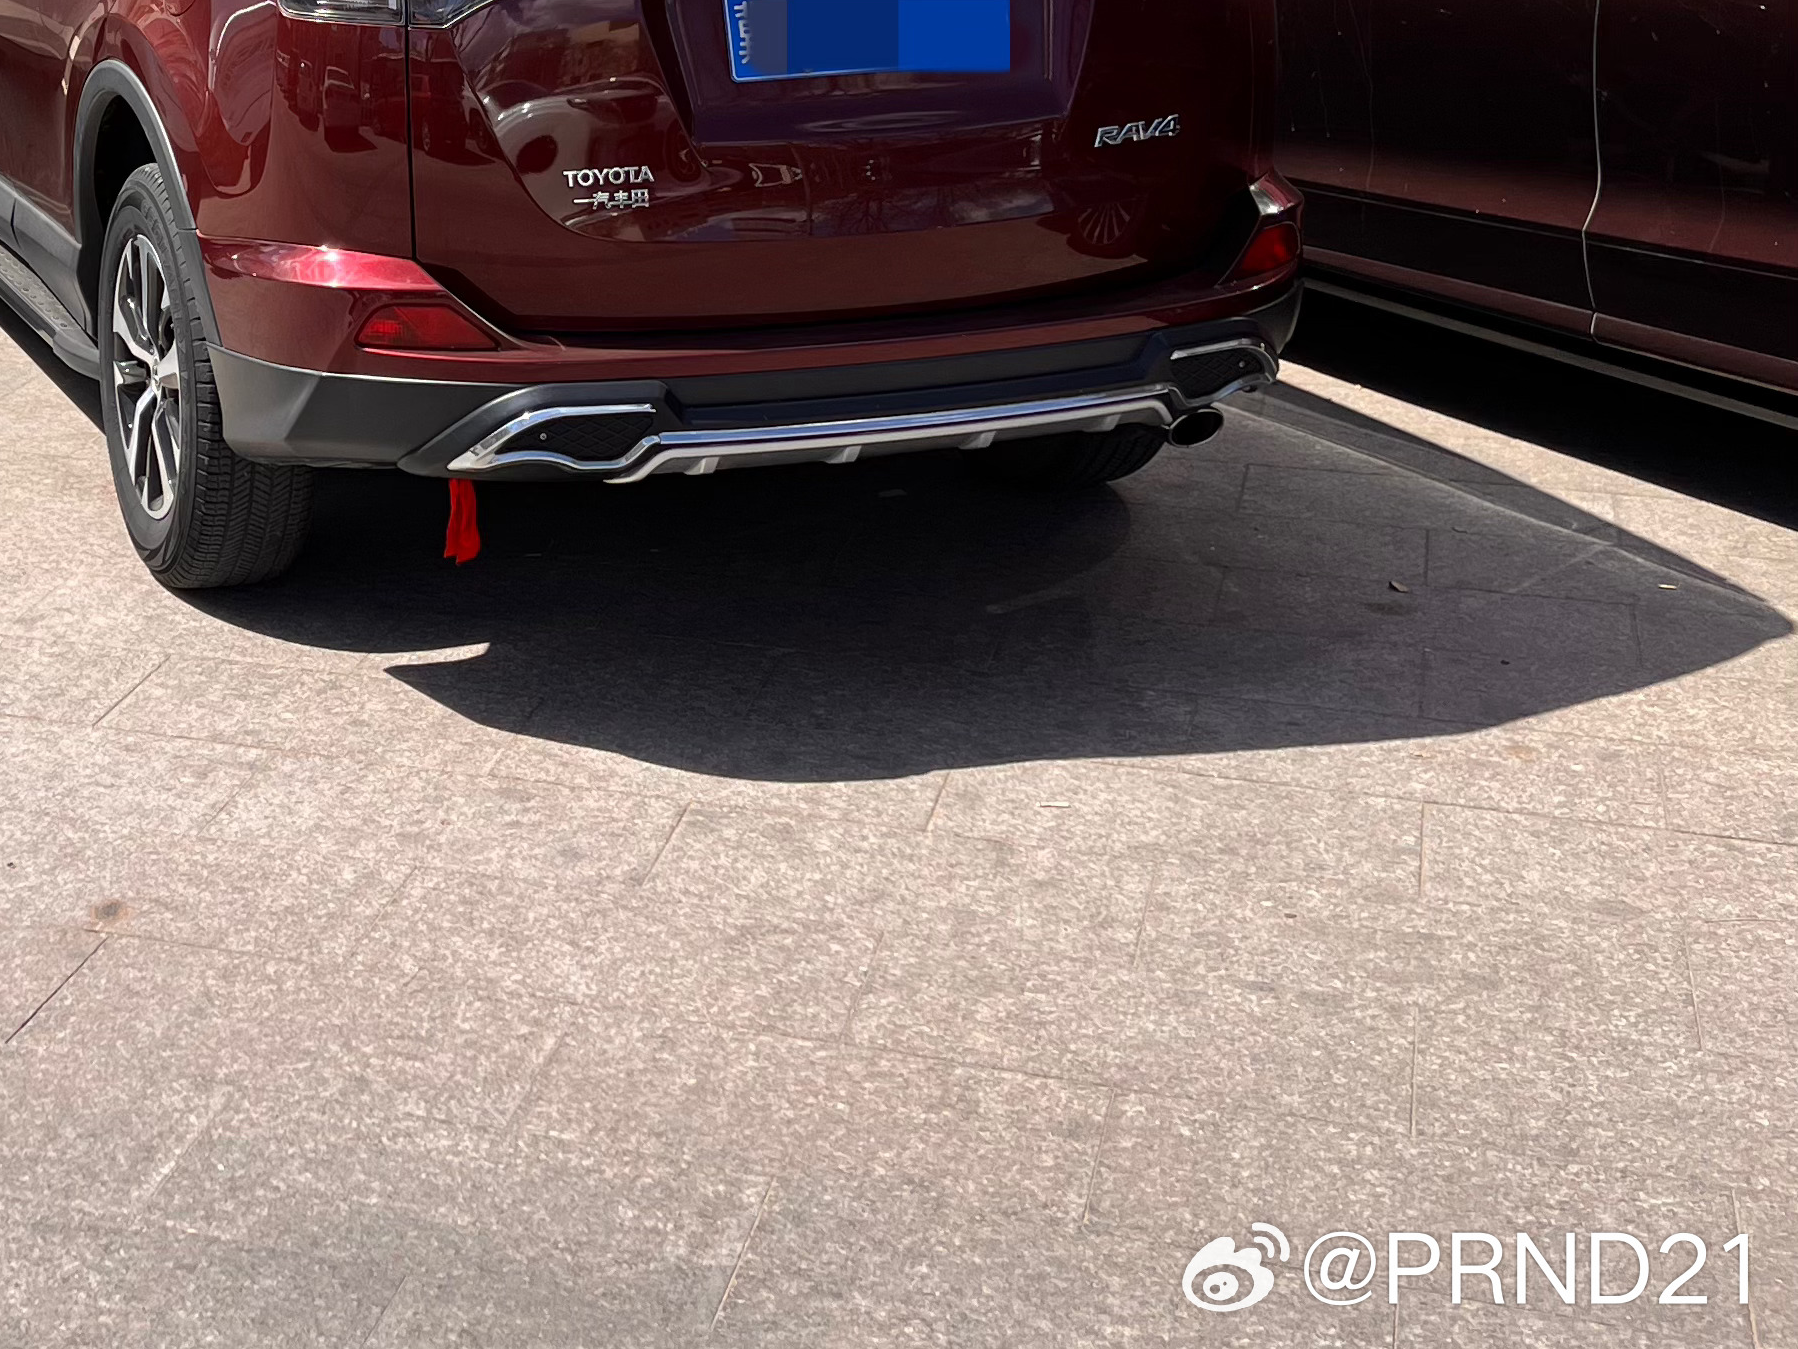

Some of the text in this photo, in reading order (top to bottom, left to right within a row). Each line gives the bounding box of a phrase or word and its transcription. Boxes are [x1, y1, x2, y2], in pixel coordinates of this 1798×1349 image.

[1094, 114, 1180, 147] RAV4
[563, 165, 655, 187] TOYOTA
[573, 189, 650, 210] 一汽丰田
